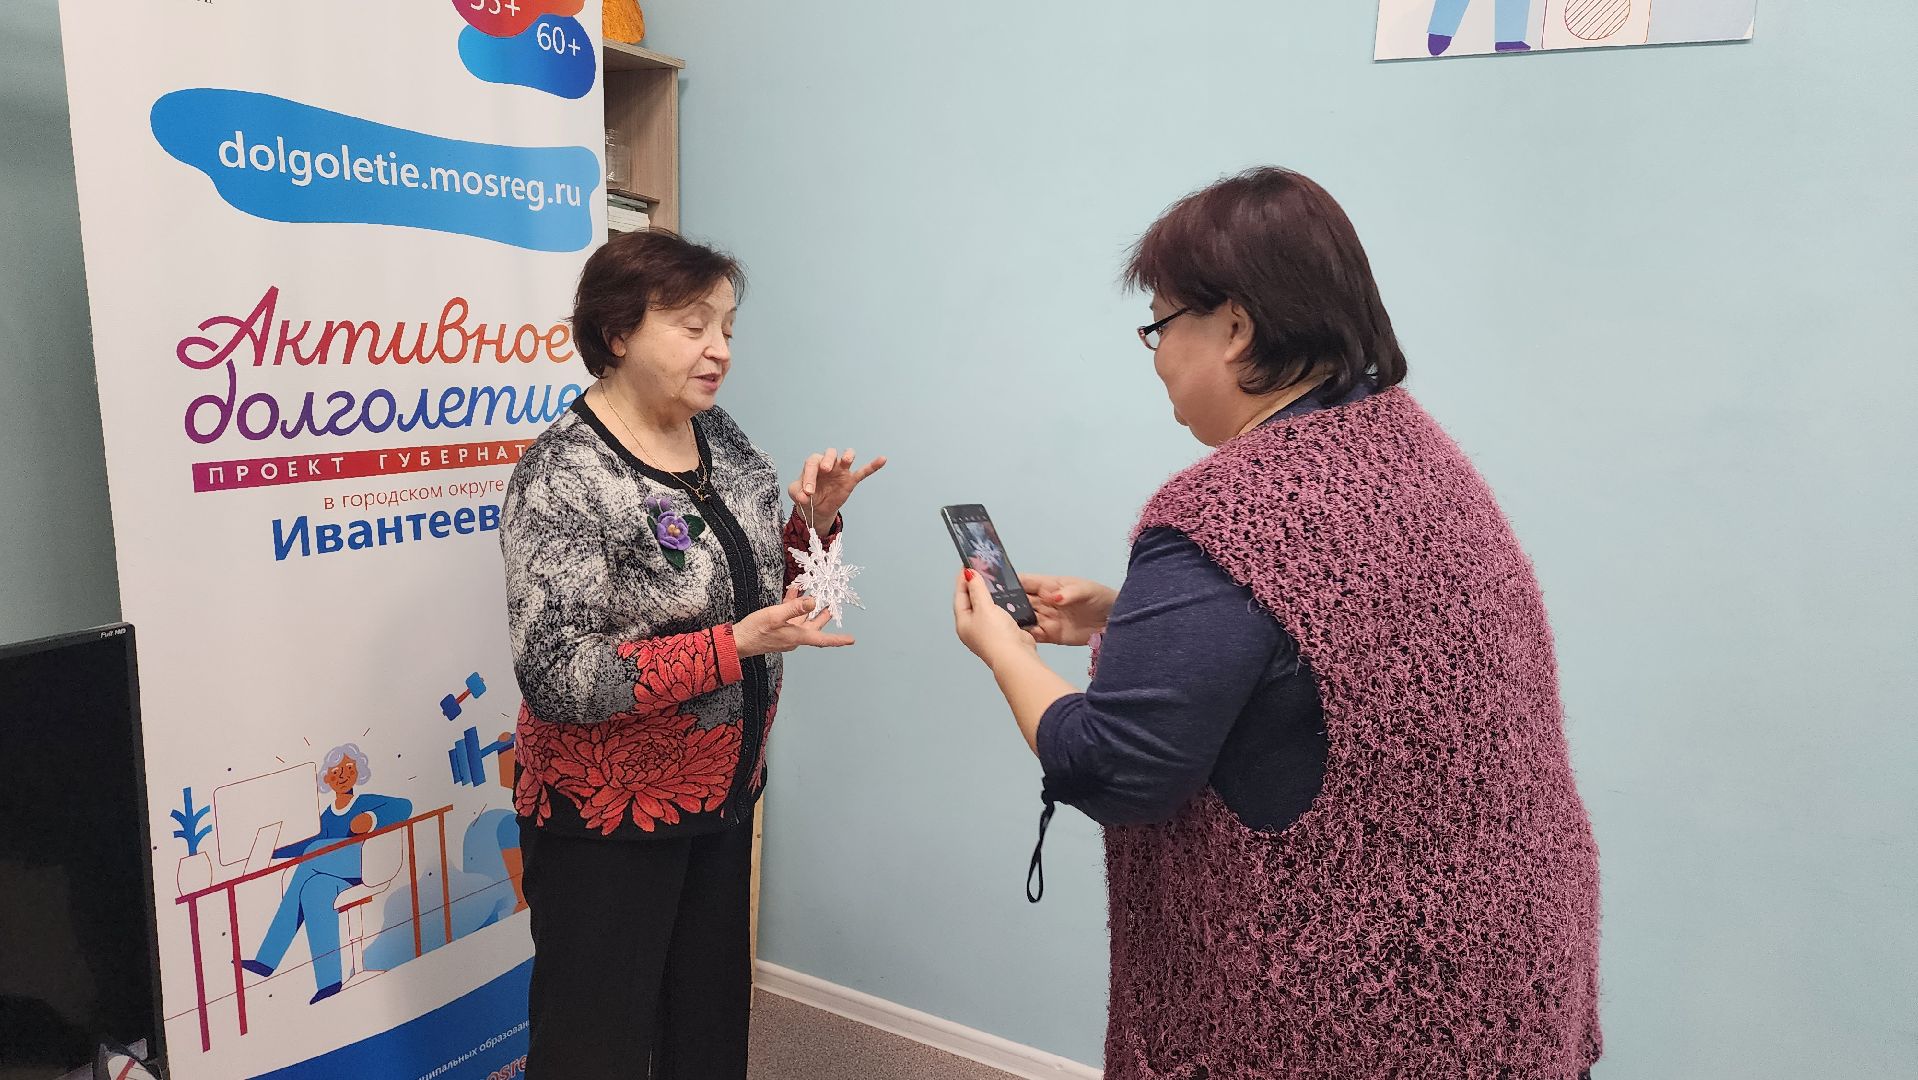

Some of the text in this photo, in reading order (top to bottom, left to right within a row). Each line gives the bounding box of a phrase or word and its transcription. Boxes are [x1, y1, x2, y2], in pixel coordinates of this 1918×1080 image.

[536, 22, 581, 57] 60+
[217, 130, 582, 212] dolgoletie.mosreg.ru
[176, 285, 575, 370] Активное
[184, 358, 582, 444] долголетие
[208, 444, 526, 485] ПРОЕКТ ГУБЕРНАТ
[324, 479, 504, 511] в городском округе
[272, 504, 501, 561] Ивантеев
[479, 1020, 529, 1052] образован
